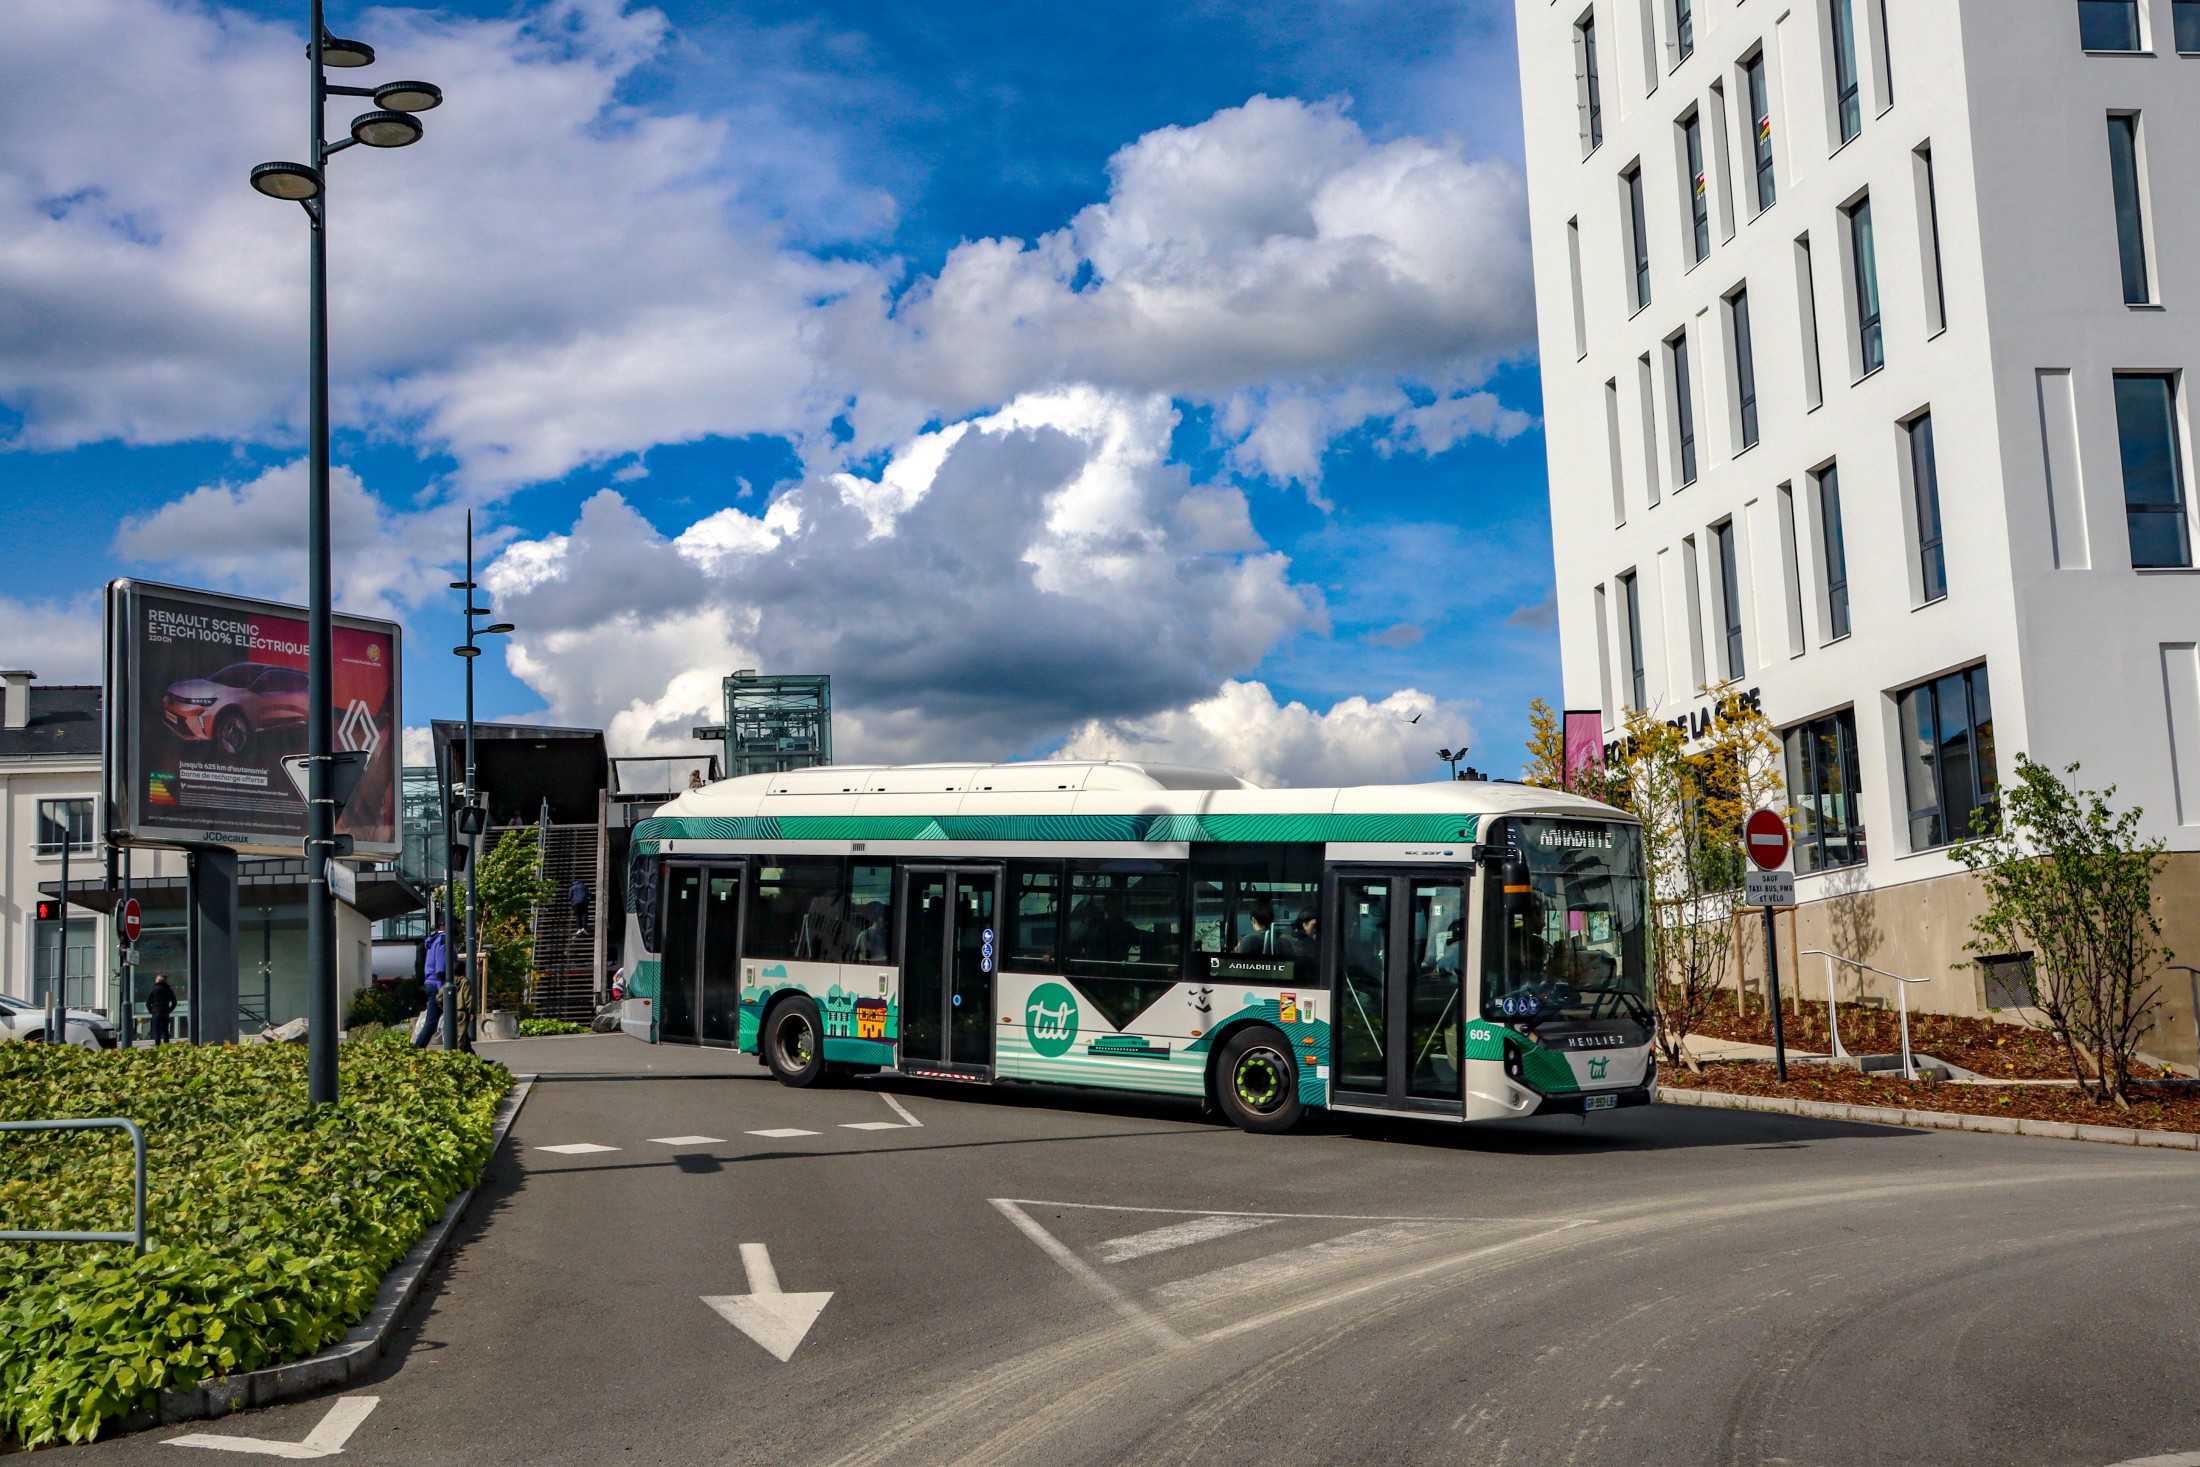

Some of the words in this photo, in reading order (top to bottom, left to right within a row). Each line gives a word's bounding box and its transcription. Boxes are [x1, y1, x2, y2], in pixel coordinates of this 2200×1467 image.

[148, 609, 209, 629] RENAULT
[211, 619, 260, 636] SCENIC
[148, 621, 196, 640] E-TECH
[198, 629, 232, 645] 100%
[235, 634, 310, 656] ELECTRIQUE
[148, 634, 162, 642] 220
[163, 636, 172, 644] CH
[1690, 706, 1712, 740] LA
[204, 763, 216, 771] 625
[217, 764, 227, 772] km
[211, 773, 241, 783] recharge
[203, 831, 249, 844] JCDecaux
[1762, 875, 1778, 883] SAUF
[1765, 885, 1779, 893] BUS,
[1780, 884, 1793, 892] PMR
[1759, 894, 1767, 902] ET
[1768, 893, 1784, 902] VÉLO
[1469, 1028, 1491, 1042] 605
[1568, 1035, 1625, 1047] HEULIEZ
